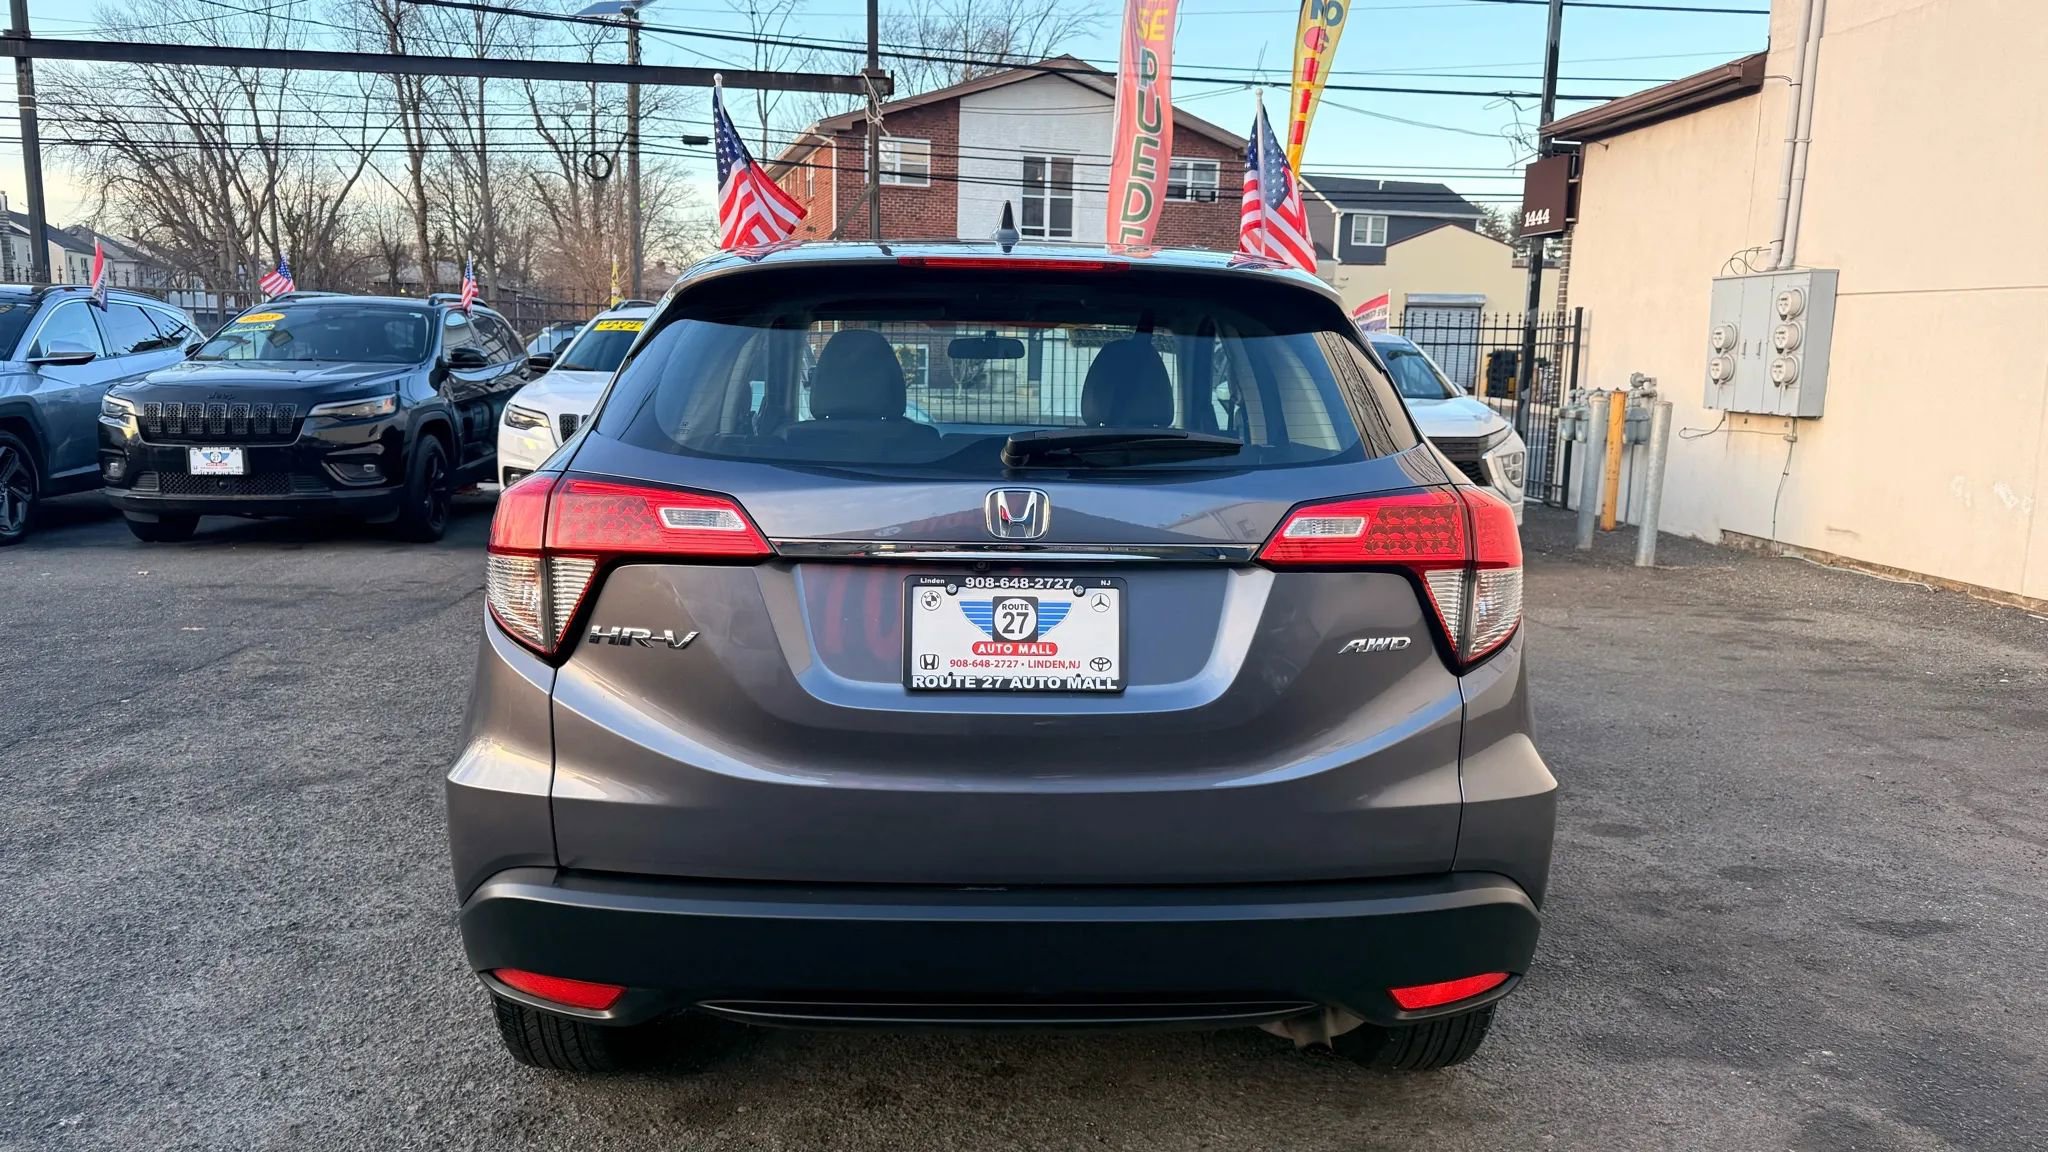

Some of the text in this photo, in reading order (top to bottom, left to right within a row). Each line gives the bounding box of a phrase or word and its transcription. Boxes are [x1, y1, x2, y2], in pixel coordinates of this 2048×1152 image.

[1524, 208, 1550, 227] 1444
[920, 577, 945, 585] Linden
[965, 576, 1074, 589] 908-648-2727
[1001, 603, 1029, 611] ROUTE
[1001, 611, 1029, 635] 27
[589, 625, 700, 649] HR-V
[977, 643, 1053, 655] AUTO MALL
[1338, 636, 1412, 654] AWD
[949, 659, 1081, 671] 908-648-2727 LINDEN,NJ
[911, 674, 1118, 690] ROUTE 27 AUTO MALL
